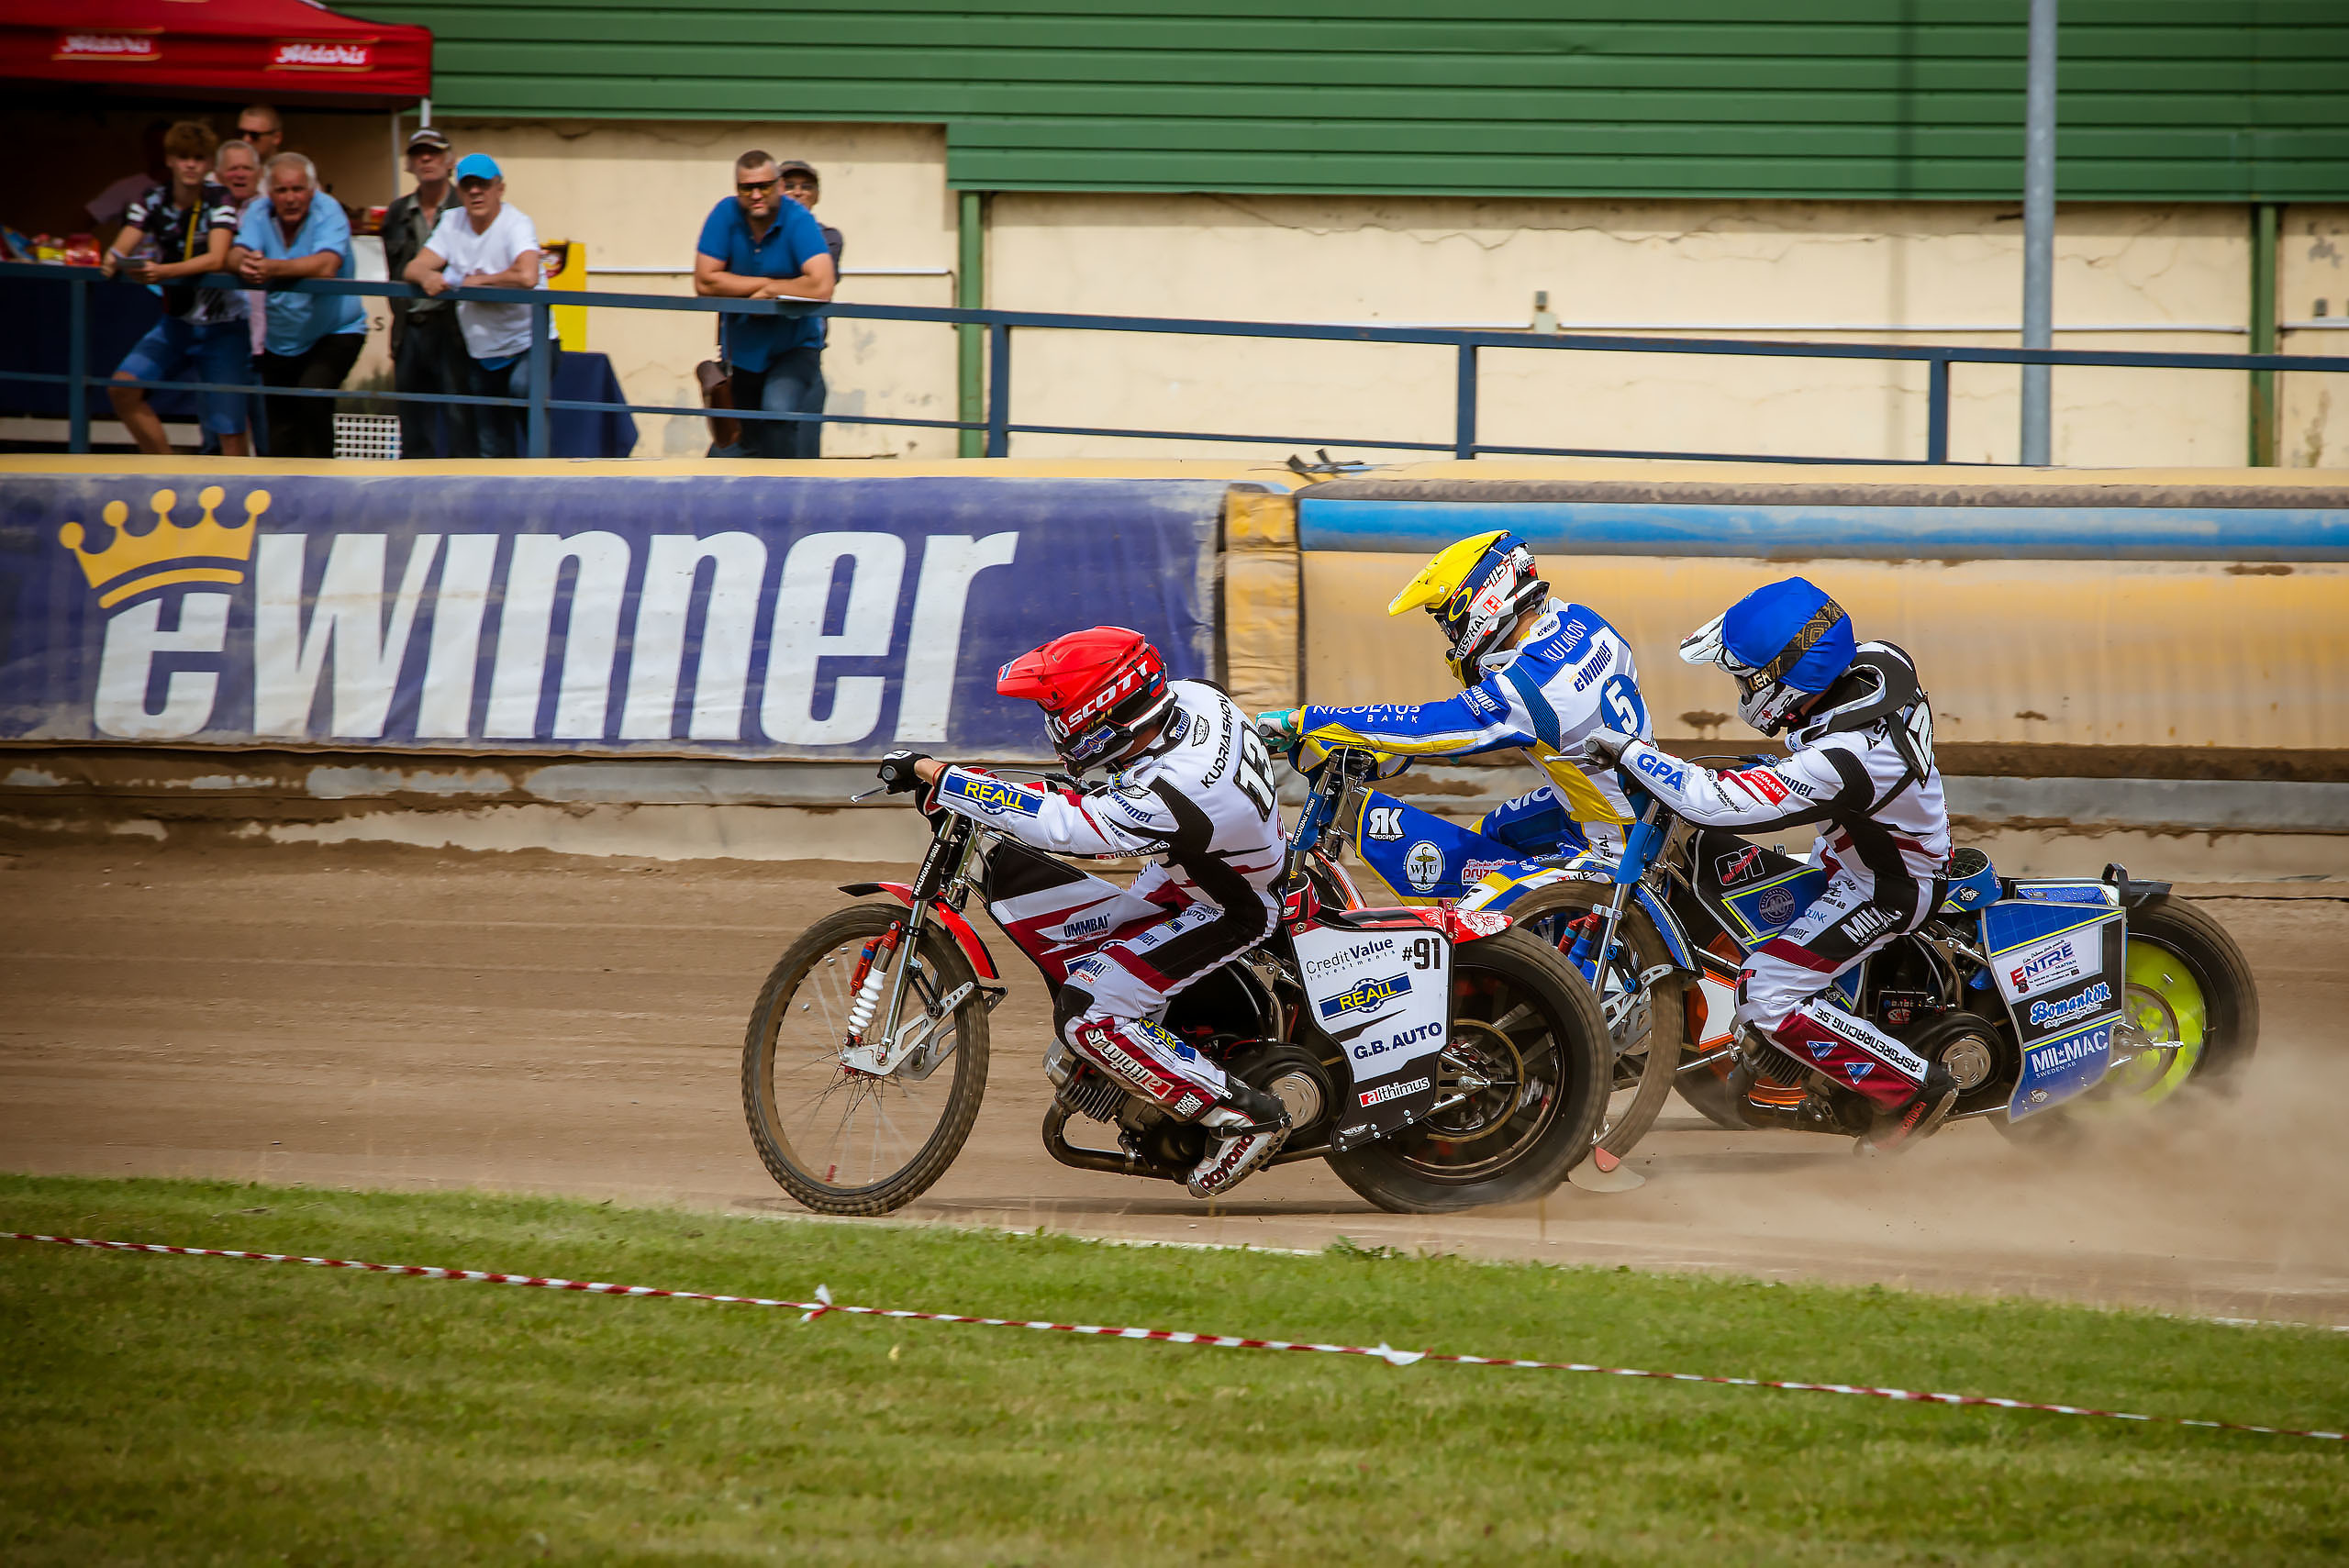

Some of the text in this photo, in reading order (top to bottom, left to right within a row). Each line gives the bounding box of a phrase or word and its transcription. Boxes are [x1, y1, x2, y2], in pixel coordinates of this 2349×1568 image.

[275, 44, 367, 65] Aldaris
[1456, 614, 1489, 659] VESTHAL
[1541, 618, 1588, 662] KULAKOV
[1748, 655, 1782, 692] LEATT
[1068, 660, 1149, 728] SCOTT
[1605, 679, 1639, 735] 5
[1366, 715, 1419, 724] BANK
[1200, 694, 1233, 789] KUDRIASHOV
[1239, 728, 1276, 810] 13
[1637, 753, 1685, 792] GPA
[964, 781, 1024, 810] REALL
[1375, 833, 1397, 841] racing
[913, 861, 933, 896] MALINIAK
[1401, 937, 1442, 971] #91
[2009, 942, 2075, 987] ENTRE
[1339, 982, 1398, 1011] REALL
[2030, 981, 2112, 1026] Bomankök
[1086, 1028, 1164, 1091] althimus
[1353, 1021, 1443, 1060] G.B. AUTO
[1364, 1077, 1431, 1105] althimus
[2035, 1064, 2065, 1079] SWEDEN
[1198, 1134, 1256, 1191] daytona
